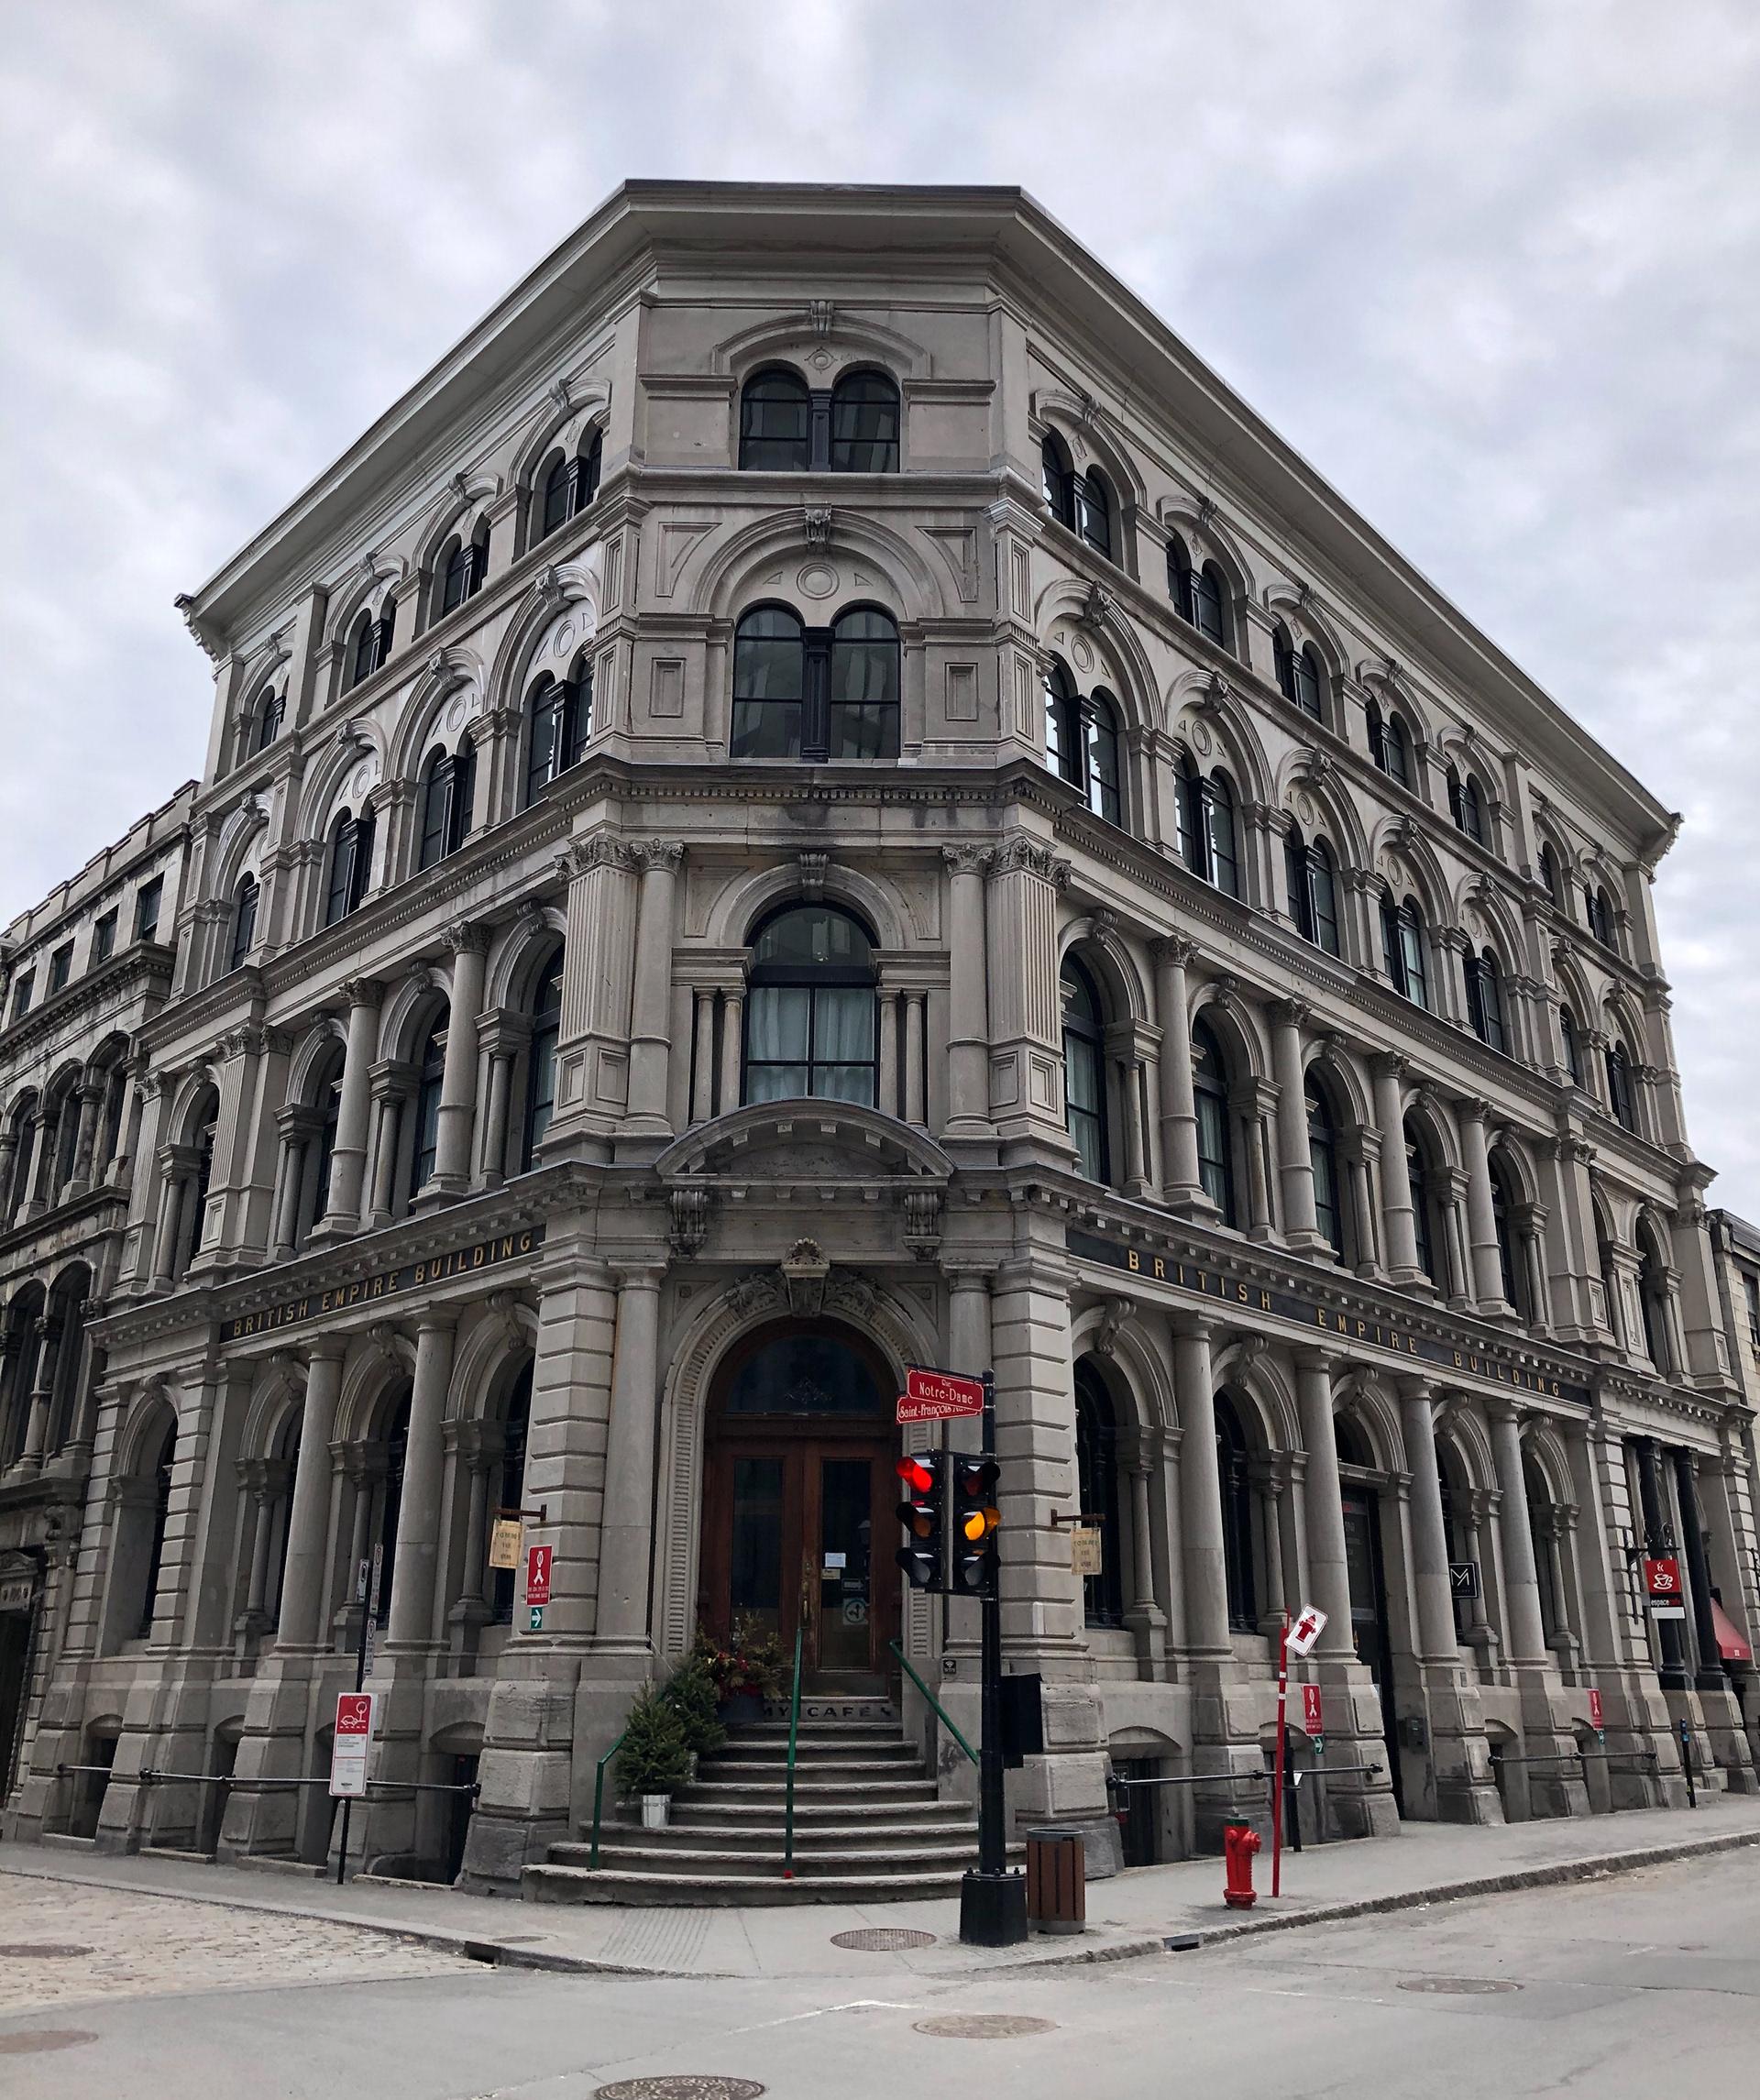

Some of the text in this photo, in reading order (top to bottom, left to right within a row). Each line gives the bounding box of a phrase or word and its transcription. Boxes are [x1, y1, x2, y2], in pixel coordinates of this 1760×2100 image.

[233, 1231, 533, 1336] BRITISH EMPIRE BUILDING
[1128, 1249, 1560, 1398] BRITISH EMPIRE BUILDING
[918, 1381, 974, 1405] Notre-Dame
